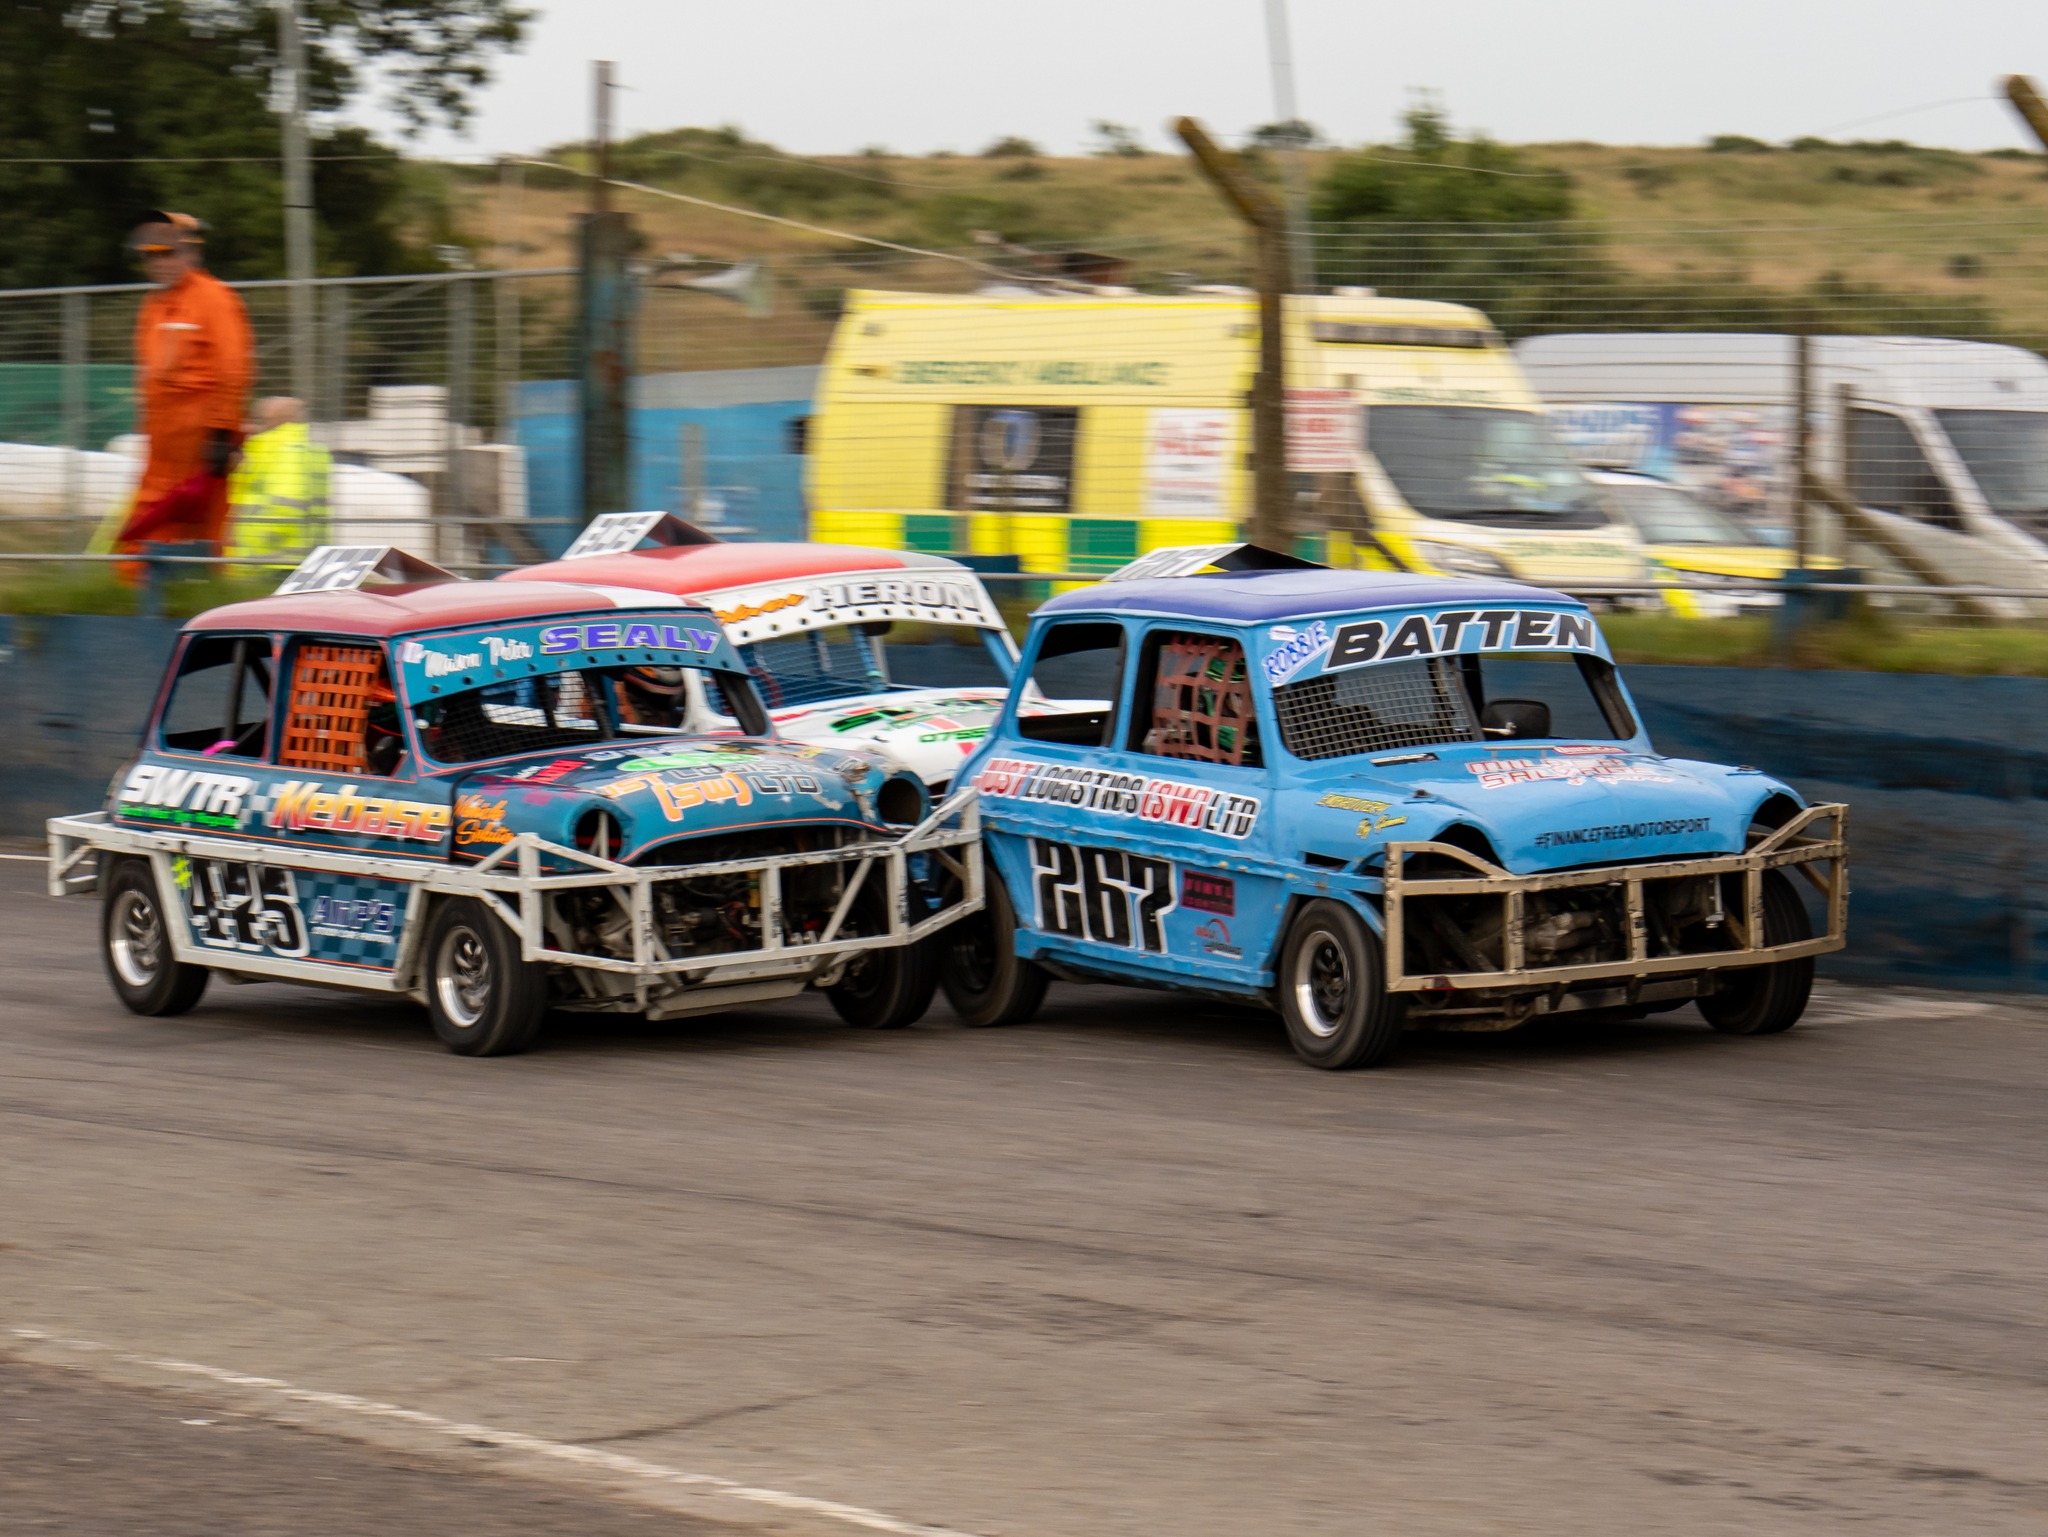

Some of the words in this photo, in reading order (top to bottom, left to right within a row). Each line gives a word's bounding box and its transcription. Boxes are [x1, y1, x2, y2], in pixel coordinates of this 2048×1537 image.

[808, 579, 982, 613] HERON
[540, 623, 722, 655] SEALY
[1266, 620, 1330, 683] ROBBIE
[1322, 610, 1597, 672] BATTEN
[119, 764, 253, 816] SWTR
[268, 780, 453, 843] Kebase
[651, 771, 753, 823] (SW)
[746, 774, 824, 795] LTD
[973, 759, 1035, 796] JUST
[1023, 763, 1147, 815] LOGISTICS
[1204, 788, 1261, 839] LTD
[1480, 766, 1661, 789] SALVAGE
[1534, 816, 1712, 849] #FINANCEFREEMOTORSPORT
[1027, 837, 1177, 955] 267
